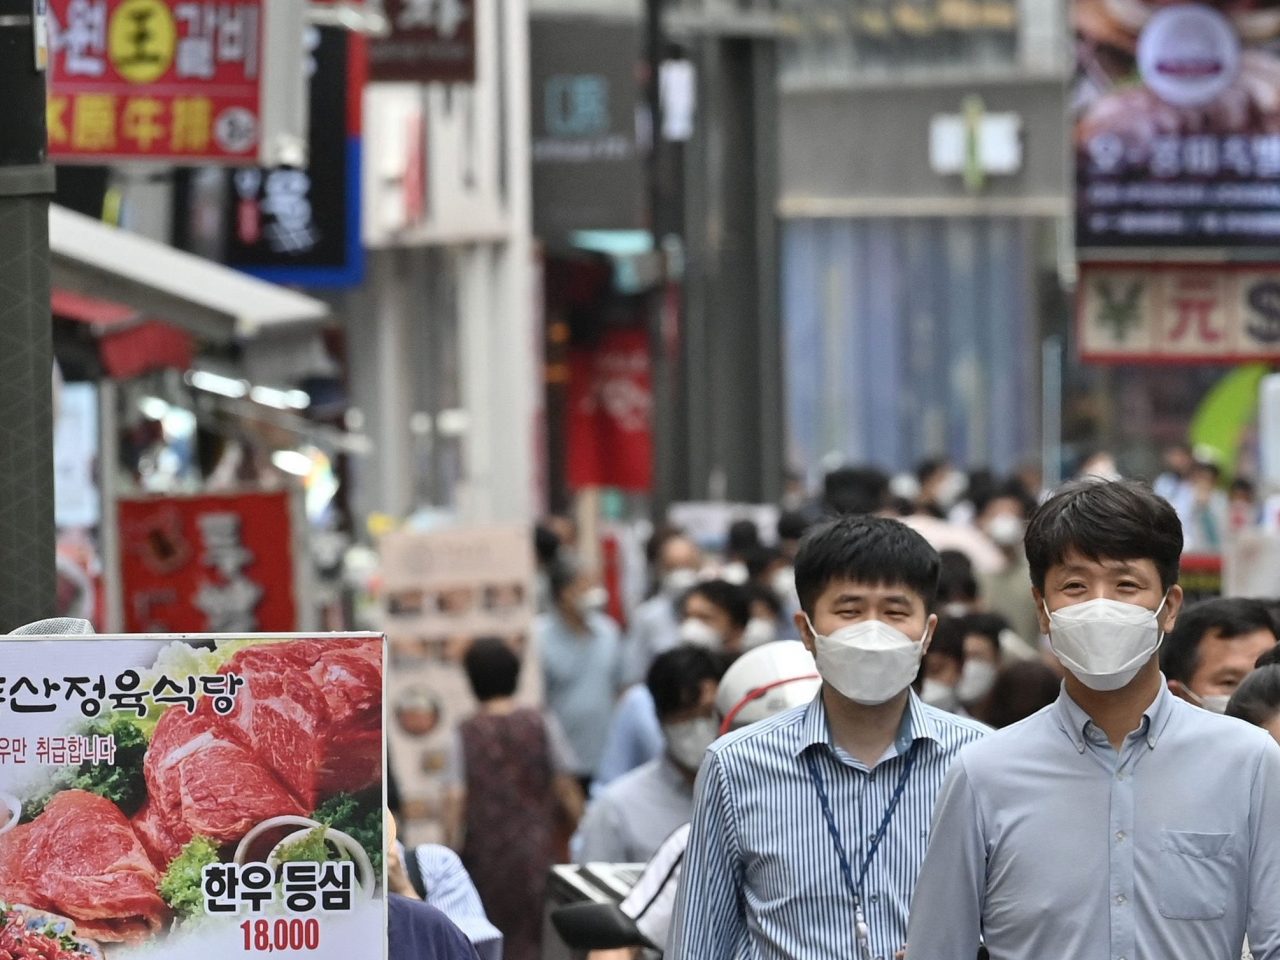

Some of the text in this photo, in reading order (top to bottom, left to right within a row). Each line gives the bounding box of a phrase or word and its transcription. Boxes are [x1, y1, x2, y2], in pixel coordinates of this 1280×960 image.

[0, 669, 243, 717] 산정육식당
[36, 735, 116, 765] 취급합니다
[205, 865, 351, 912] 한우 등심
[240, 918, 320, 952] 18,000
